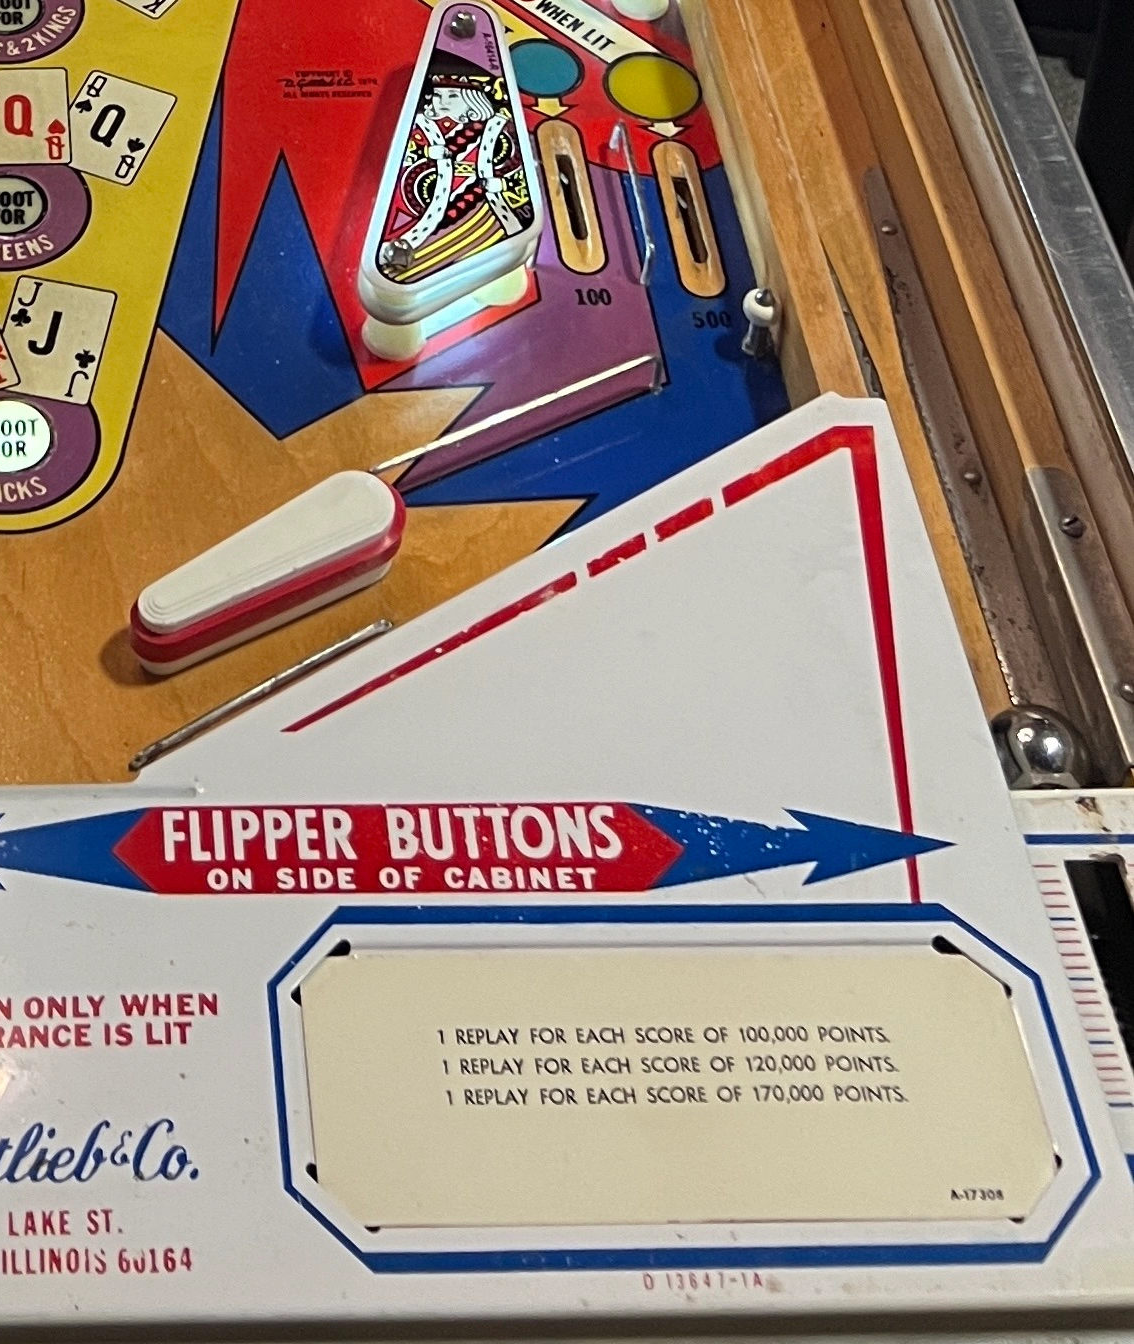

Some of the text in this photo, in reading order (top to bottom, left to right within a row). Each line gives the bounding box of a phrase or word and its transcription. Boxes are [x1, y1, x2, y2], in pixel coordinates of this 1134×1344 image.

[6, 41, 20, 54] &
[22, 37, 37, 52] 2
[34, 5, 77, 45] KINGS
[578, 28, 616, 52] LIT
[575, 288, 612, 305] 100
[693, 312, 731, 328] 500
[161, 805, 624, 861] FLIPPER BUTTONS
[207, 866, 597, 890] ON SIDE OF CABINET
[23, 995, 105, 1019] ONLY
[120, 993, 218, 1016] WHEN
[104, 1023, 133, 1046] IS
[146, 1022, 192, 1045] LIT
[437, 1026, 891, 1045] 1 REPLAY FOR EACH SCORE OF 100,000 POINTS.
[443, 1055, 900, 1075] 1 REPLAY FOR EACH SCORE OF 120,000 POINTS.
[446, 1084, 908, 1105] 1 REPLAY FOR EACH SCORE OF 170,000 POINTS.
[8, 1210, 71, 1236] LAKE
[87, 1208, 124, 1235] ST.
[2, 1248, 107, 1276] ILLINOIS
